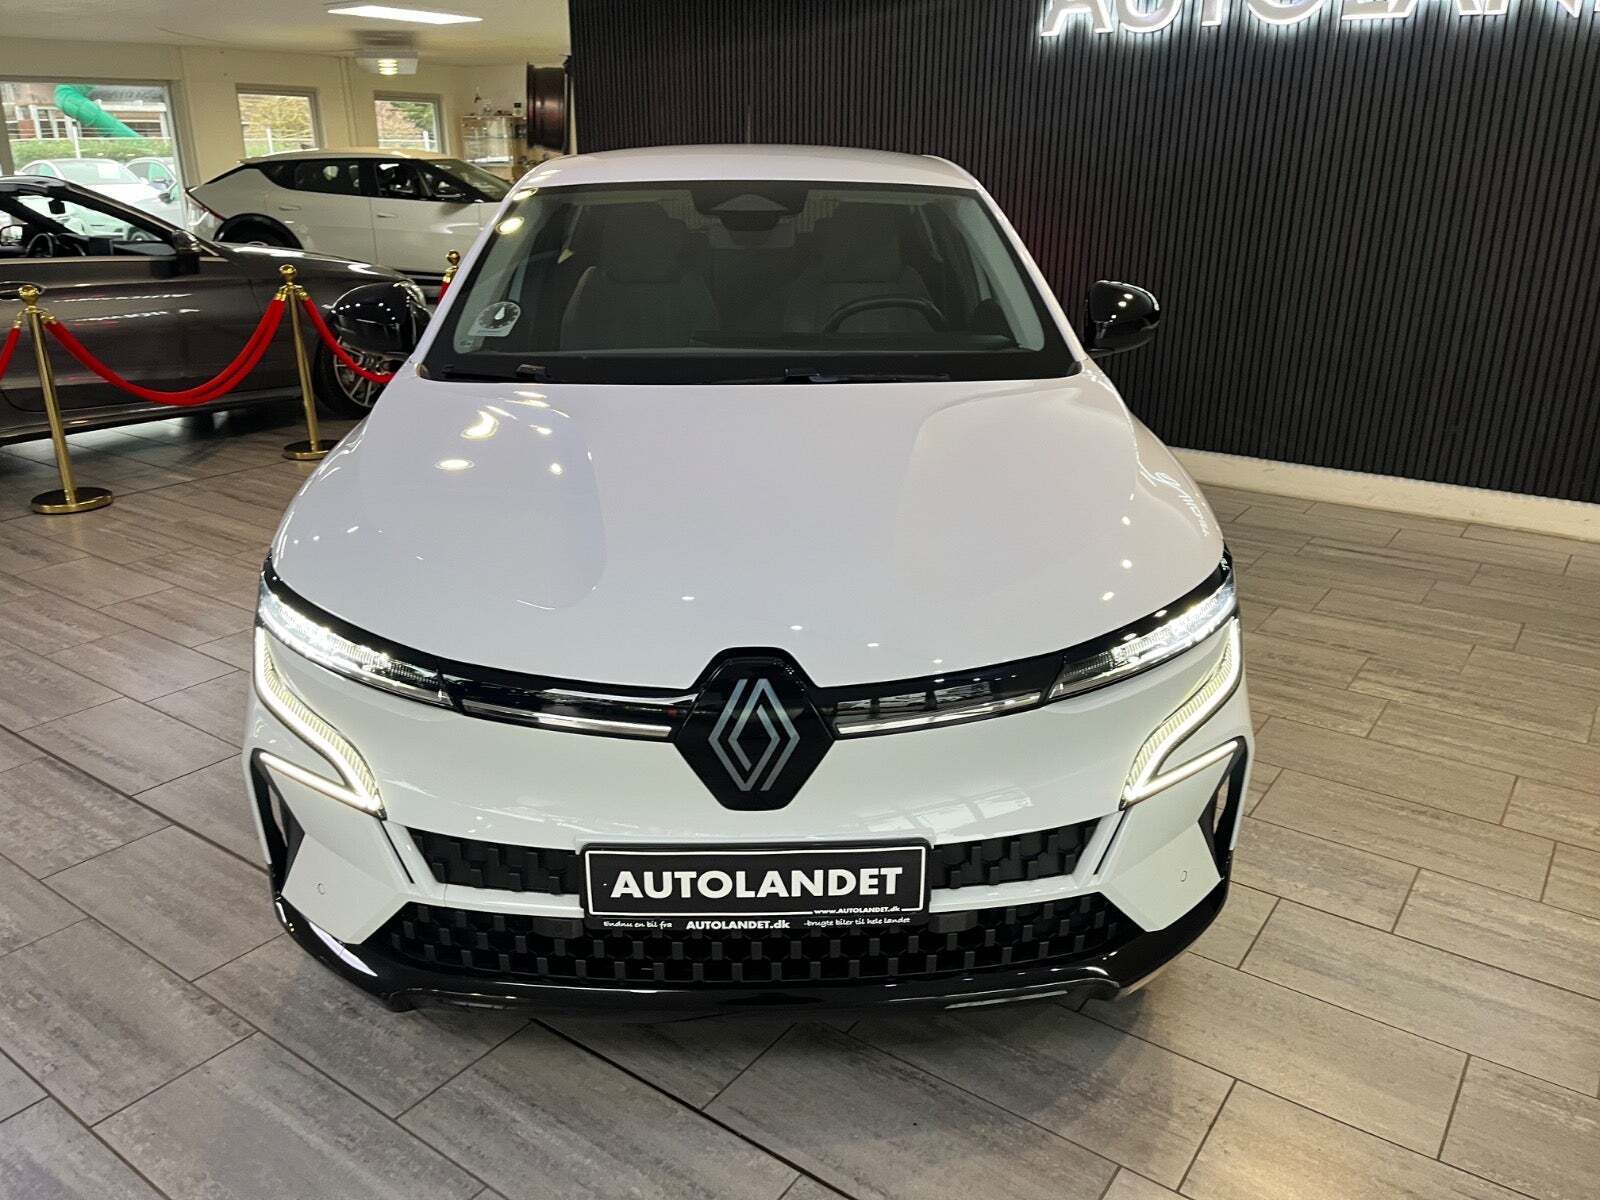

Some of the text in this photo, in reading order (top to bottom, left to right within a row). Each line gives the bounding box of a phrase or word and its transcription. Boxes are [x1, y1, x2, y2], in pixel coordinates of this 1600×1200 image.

[610, 867, 903, 899] AUTOLANDET
[813, 906, 900, 914] www.AUTOLANDET.dk
[685, 920, 791, 930] AUTOLANDET.dk
